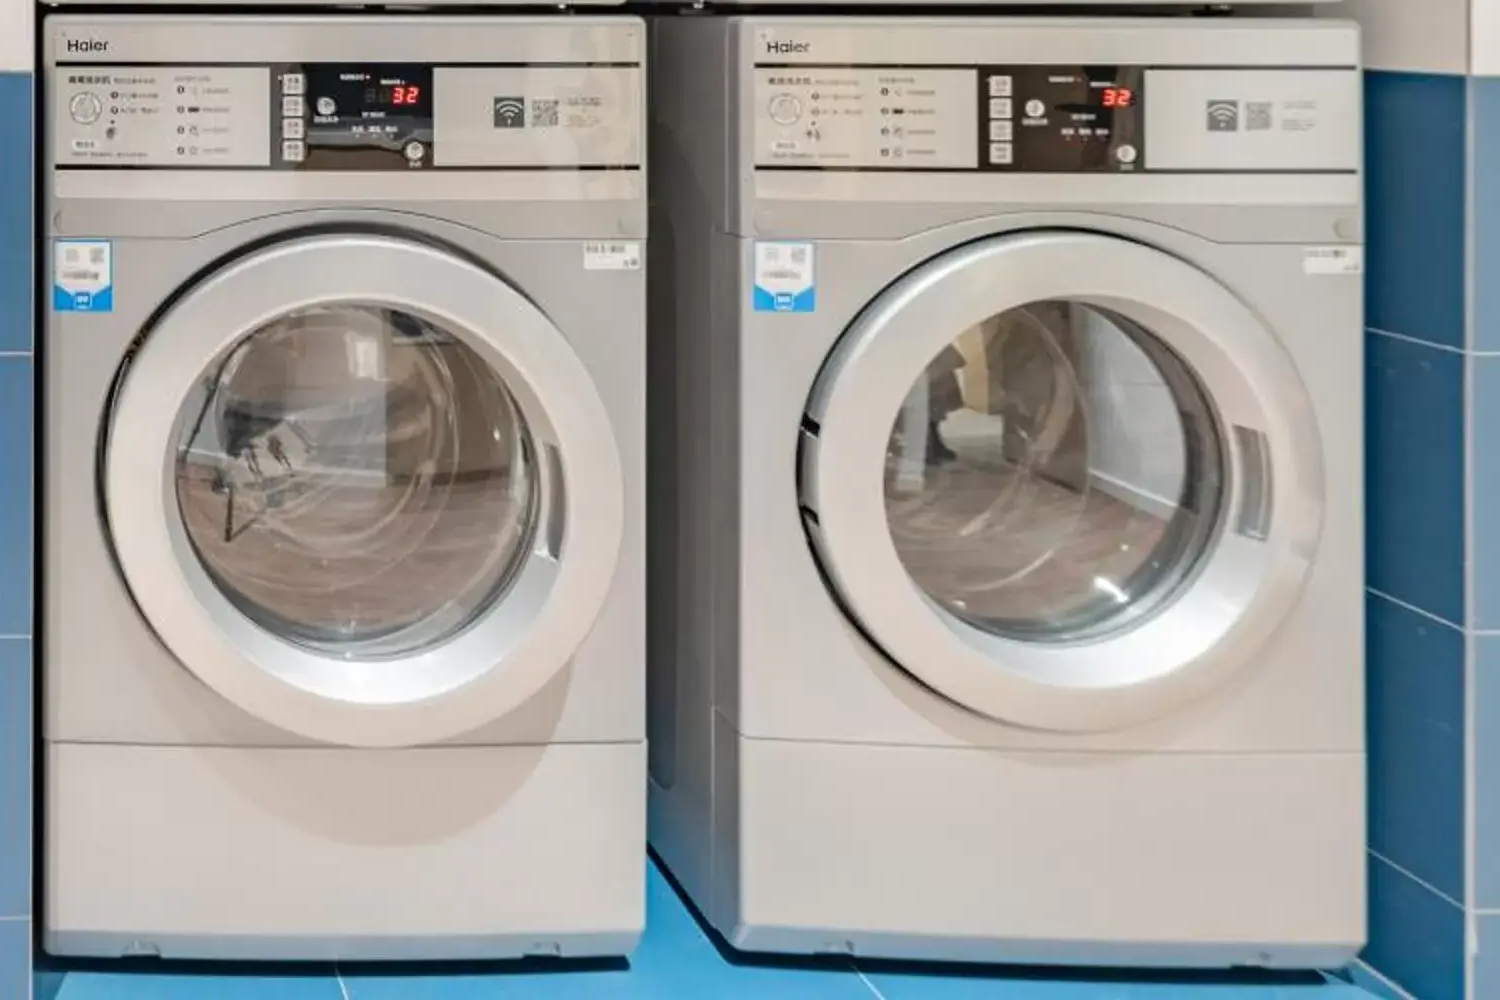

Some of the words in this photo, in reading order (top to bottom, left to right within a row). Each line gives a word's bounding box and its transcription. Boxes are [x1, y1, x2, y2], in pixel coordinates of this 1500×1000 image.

[67, 38, 109, 52] Haier
[767, 39, 810, 53] Haier
[392, 87, 419, 104] 32
[1103, 88, 1131, 106] 32
